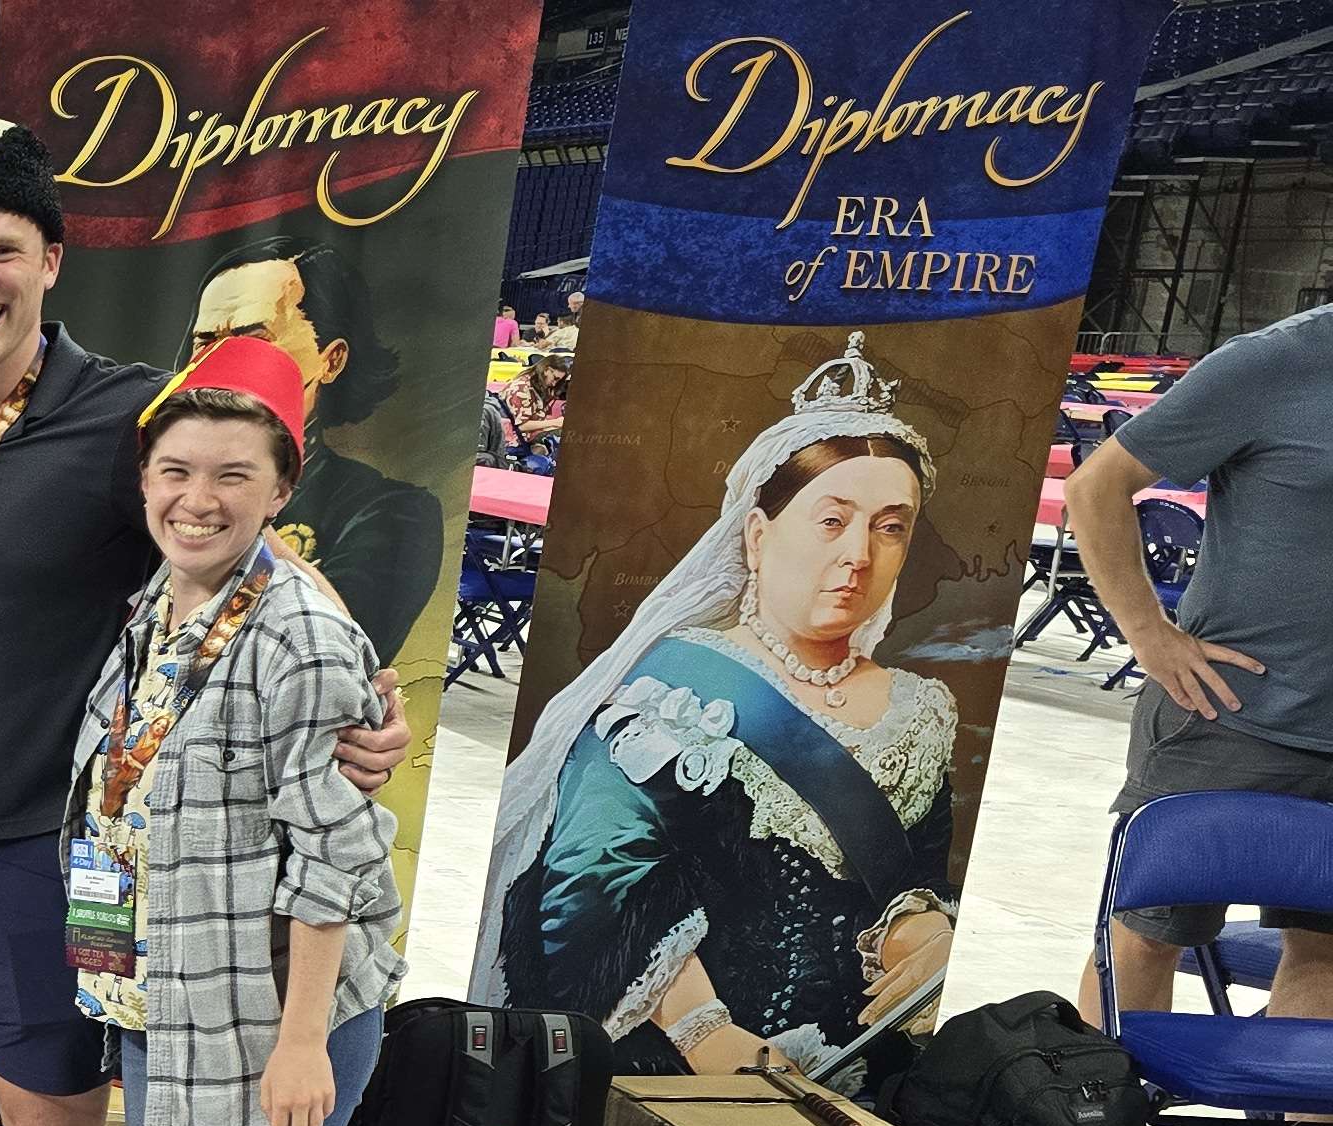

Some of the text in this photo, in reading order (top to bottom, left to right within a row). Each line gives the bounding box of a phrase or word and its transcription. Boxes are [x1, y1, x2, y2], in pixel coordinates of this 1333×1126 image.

[589, 31, 604, 45] 135
[50, 25, 480, 240] Diplomacy
[665, 9, 1106, 230] Diplomacy
[830, 196, 935, 238] ERA
[784, 245, 1036, 301] of EMPIRE
[562, 430, 641, 445] RAJPUTANA
[960, 473, 1011, 488] BENGAL
[614, 571, 665, 587] BOMBA
